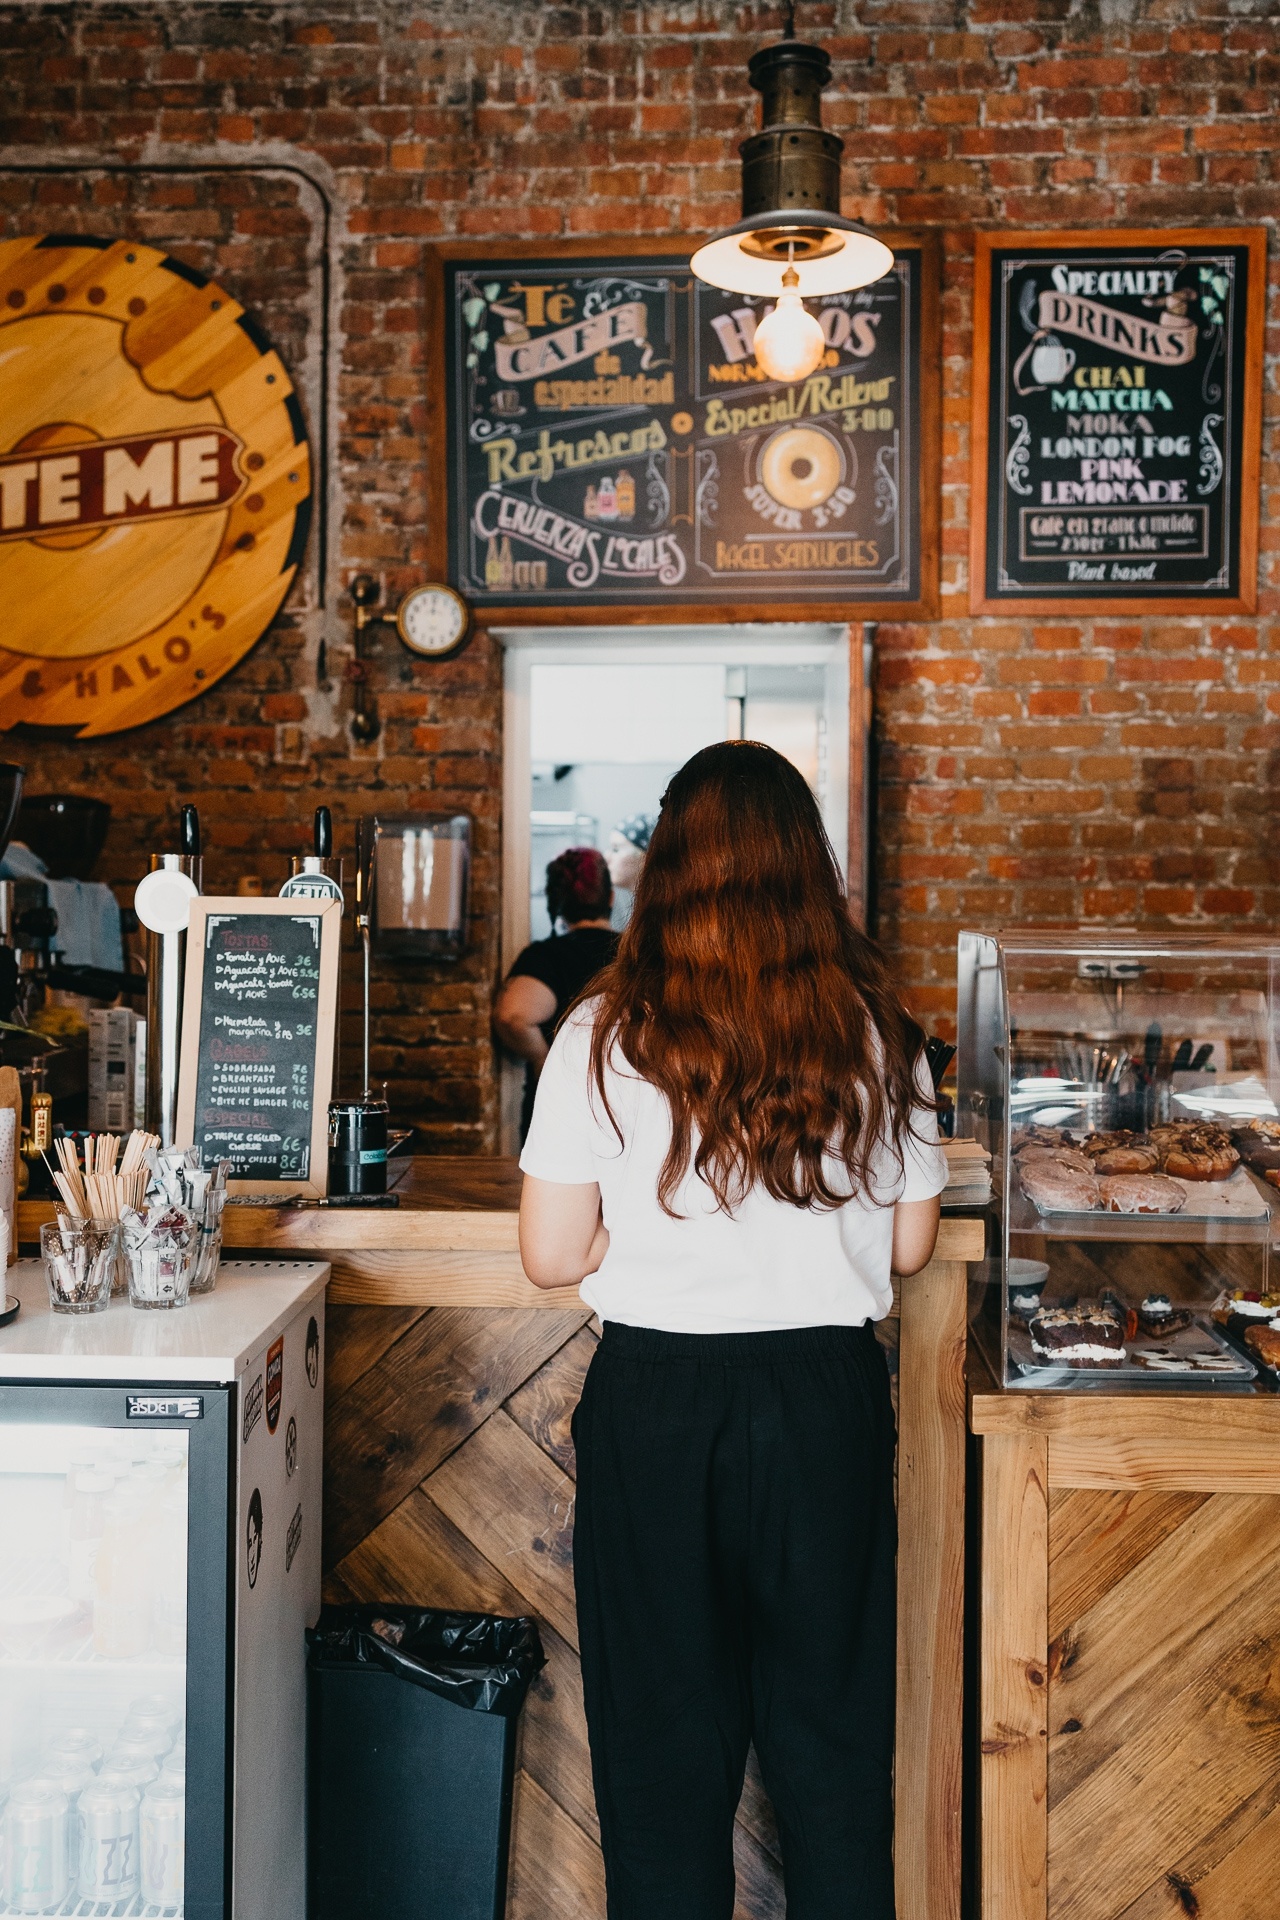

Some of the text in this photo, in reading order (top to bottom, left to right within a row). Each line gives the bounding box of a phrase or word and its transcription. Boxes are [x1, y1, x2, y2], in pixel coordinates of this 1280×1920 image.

[1051, 264, 1178, 296] SPECIALTY
[508, 283, 576, 327] Té
[710, 305, 882, 364] HOS
[1052, 298, 1185, 357] DRINKS
[1074, 365, 1146, 388] CHAI
[533, 372, 675, 411] especialidad
[1051, 389, 1173, 412] MATCHA
[1066, 413, 1155, 436] MOKA
[481, 419, 667, 483] Refrescos
[1040, 435, 1191, 458] LONDON FOG
[0, 434, 219, 530] TE ME
[1080, 458, 1145, 481] PINK
[1041, 479, 1188, 504] LEMONADE
[743, 484, 803, 530] SUPER
[475, 491, 687, 588] CERVEZAS LOCALES
[715, 540, 770, 571] BAGEL
[75, 604, 226, 699] HALO'S
[224, 951, 256, 962] Tomate
[223, 965, 267, 981] Aguacate
[218, 1085, 250, 1094] ENGLISH
[252, 1086, 287, 1095] SAUSAGE
[220, 1074, 275, 1083] BREAKFAST
[253, 1098, 288, 1107] BURGER
